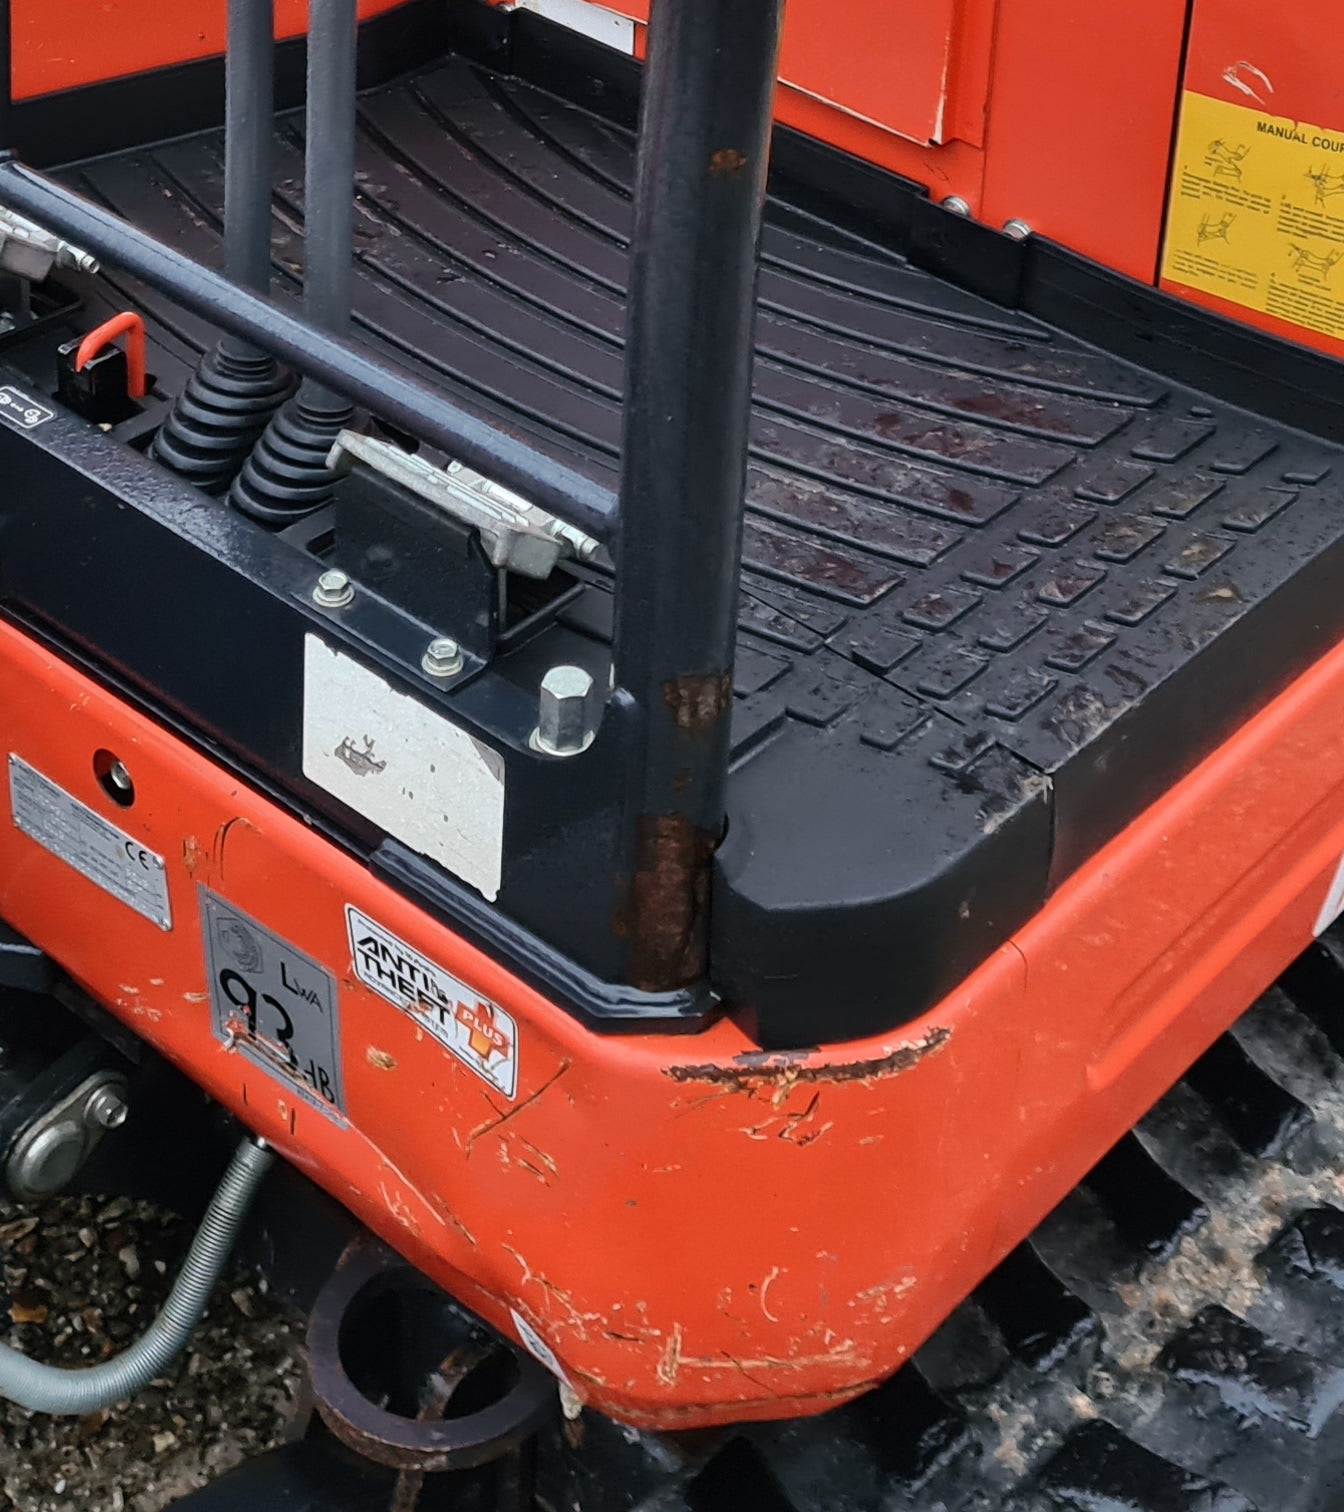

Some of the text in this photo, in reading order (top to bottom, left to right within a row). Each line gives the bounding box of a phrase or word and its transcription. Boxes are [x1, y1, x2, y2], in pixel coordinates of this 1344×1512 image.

[1256, 120, 1308, 145] MANUAL
[357, 936, 430, 990] ANTI
[357, 946, 451, 1026] THEFT
[462, 1009, 504, 1047] PLUS
